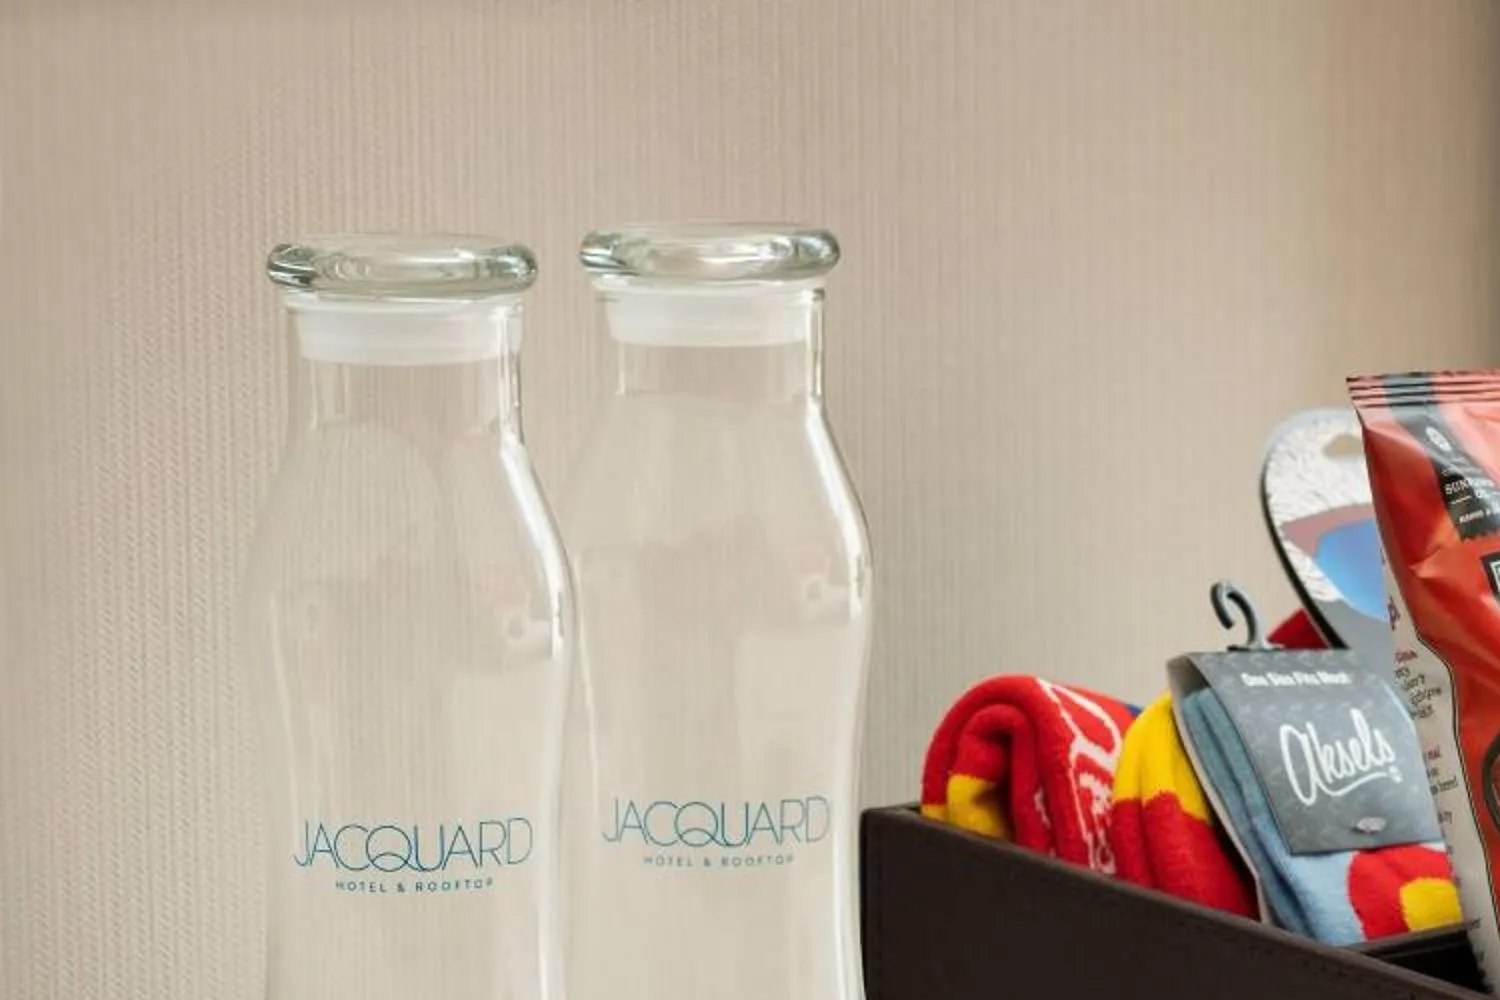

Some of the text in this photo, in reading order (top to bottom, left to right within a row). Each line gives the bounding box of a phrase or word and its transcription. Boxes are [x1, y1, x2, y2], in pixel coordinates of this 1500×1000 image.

[602, 795, 831, 848] JACQUARD
[293, 817, 534, 873] JACQUARD
[642, 855, 694, 867] HOTEL
[721, 854, 795, 868] ROOFTOP
[335, 879, 388, 894] HOTEL
[414, 877, 494, 893] ROOFTOP
